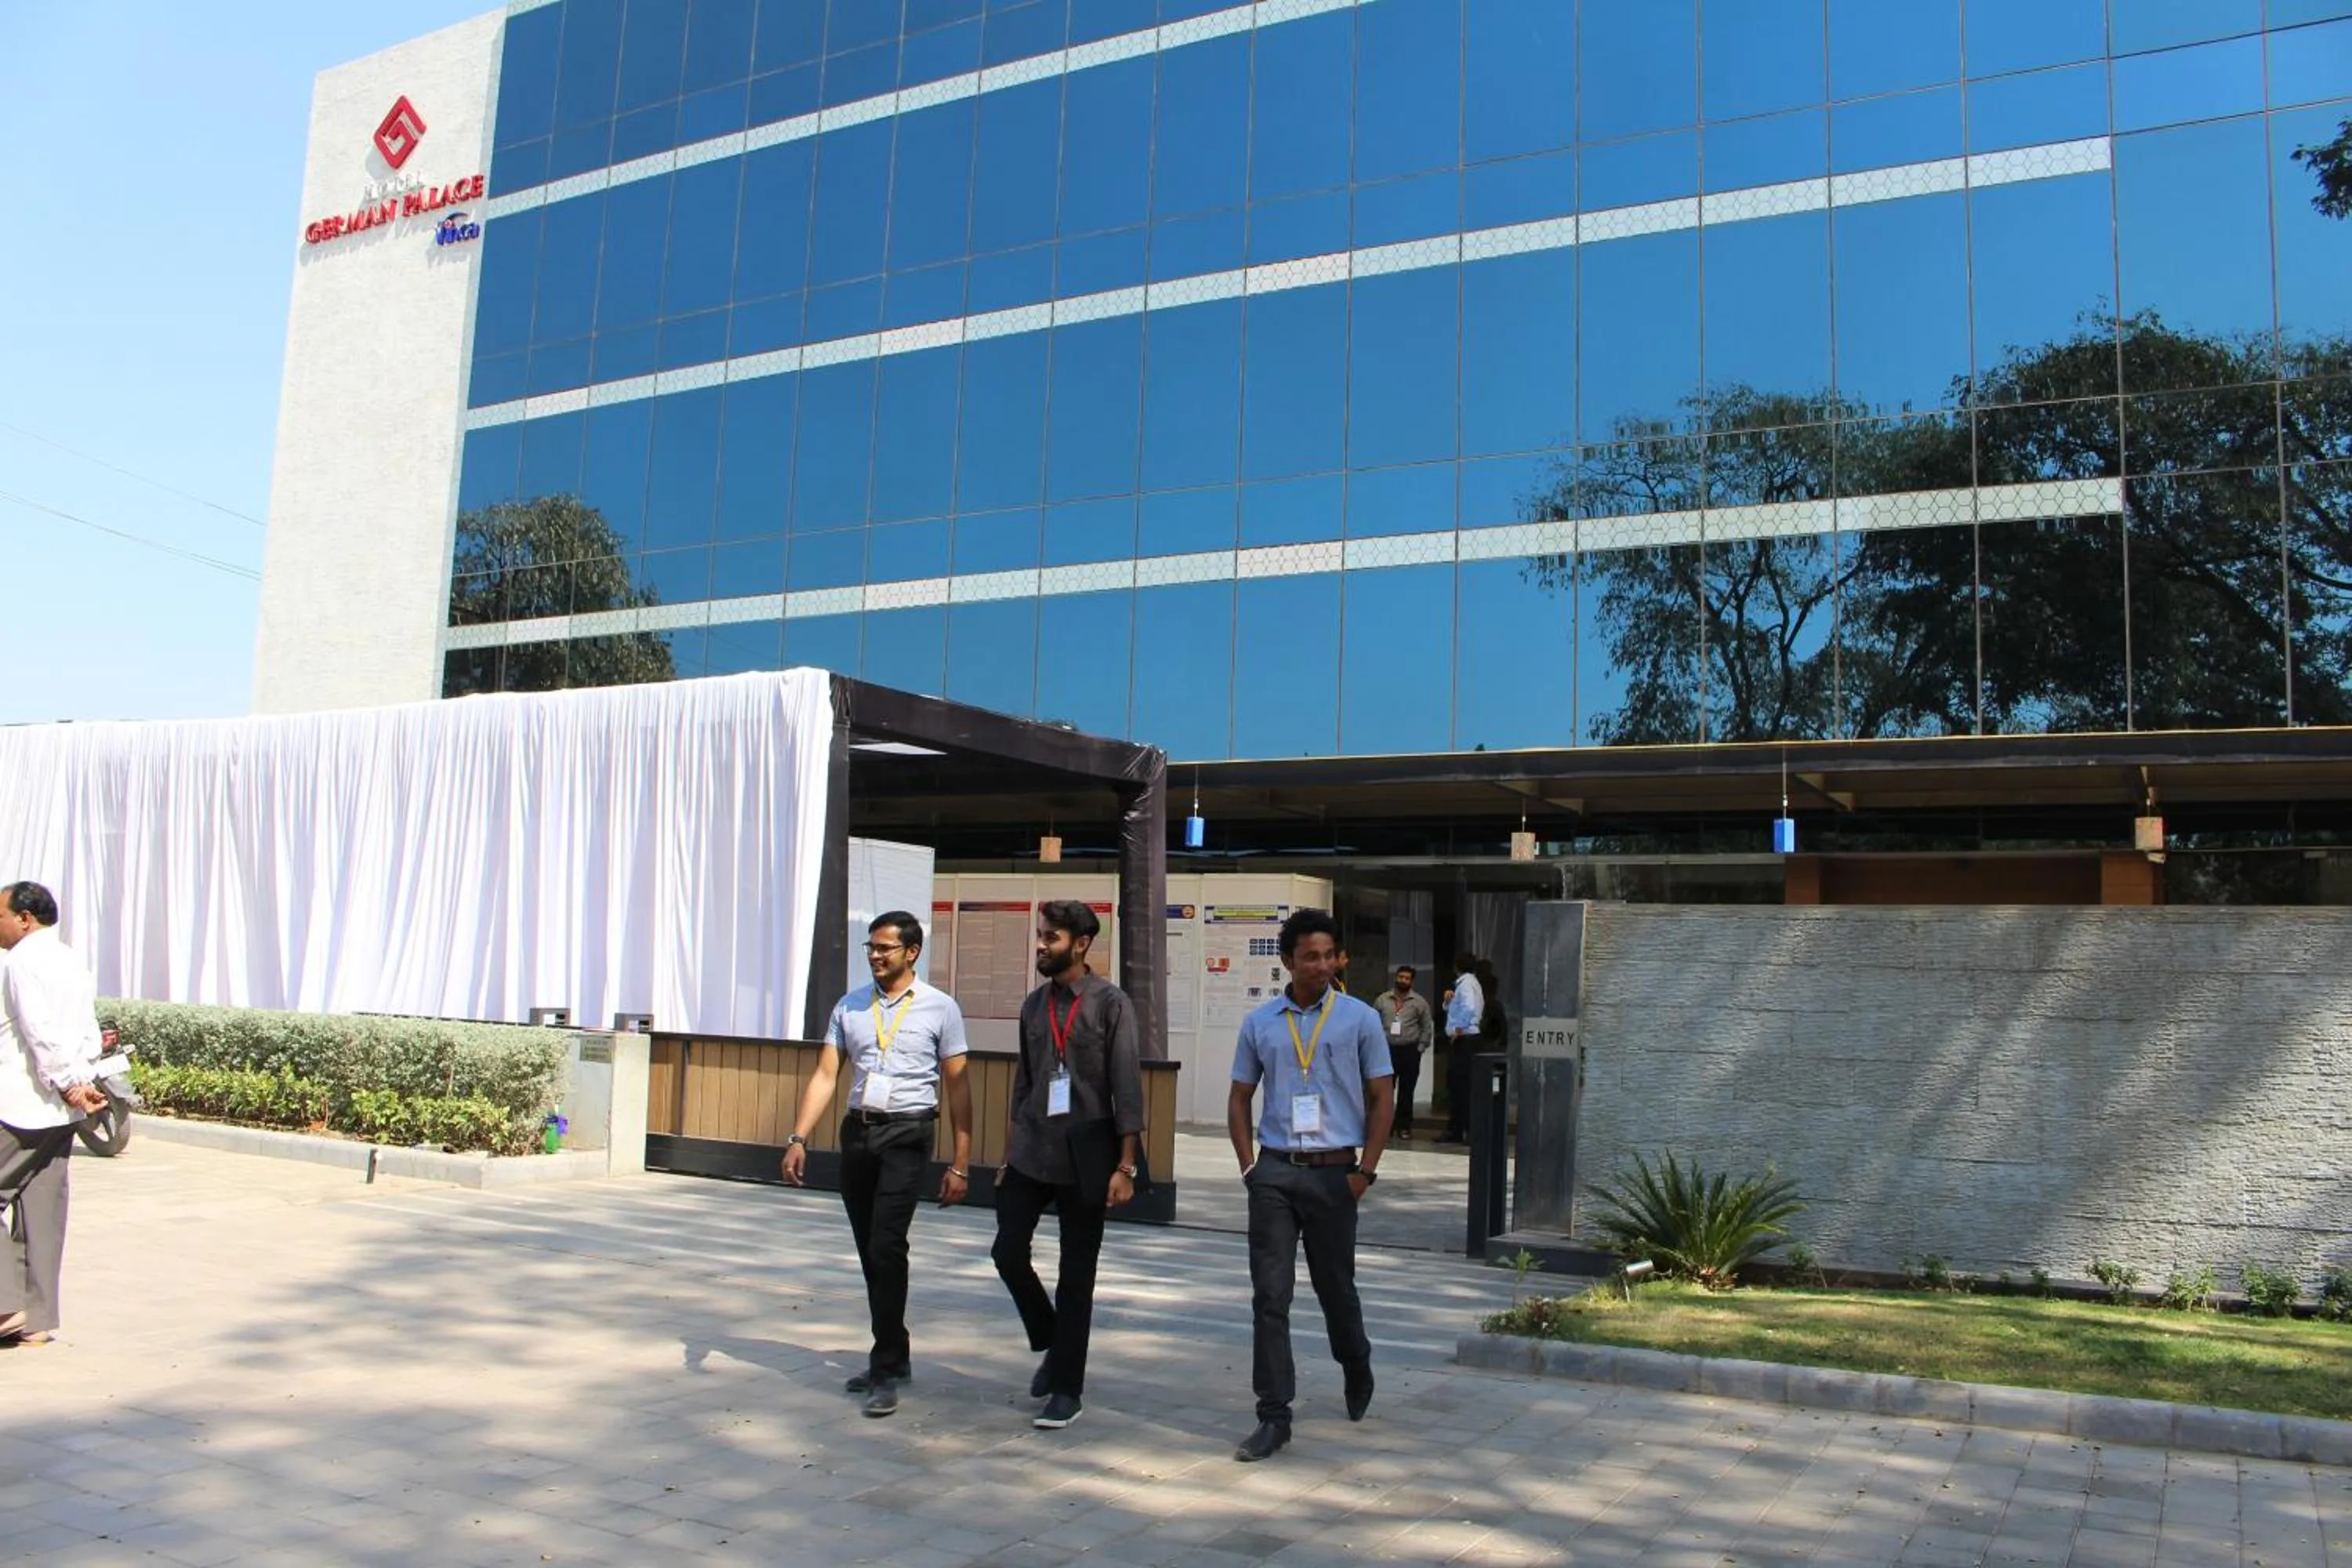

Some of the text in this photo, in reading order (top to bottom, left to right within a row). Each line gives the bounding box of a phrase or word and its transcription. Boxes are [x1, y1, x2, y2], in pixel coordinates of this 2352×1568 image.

[306, 175, 485, 244] GERMAN PALACE
[1526, 1030, 1575, 1045] ENTRY
